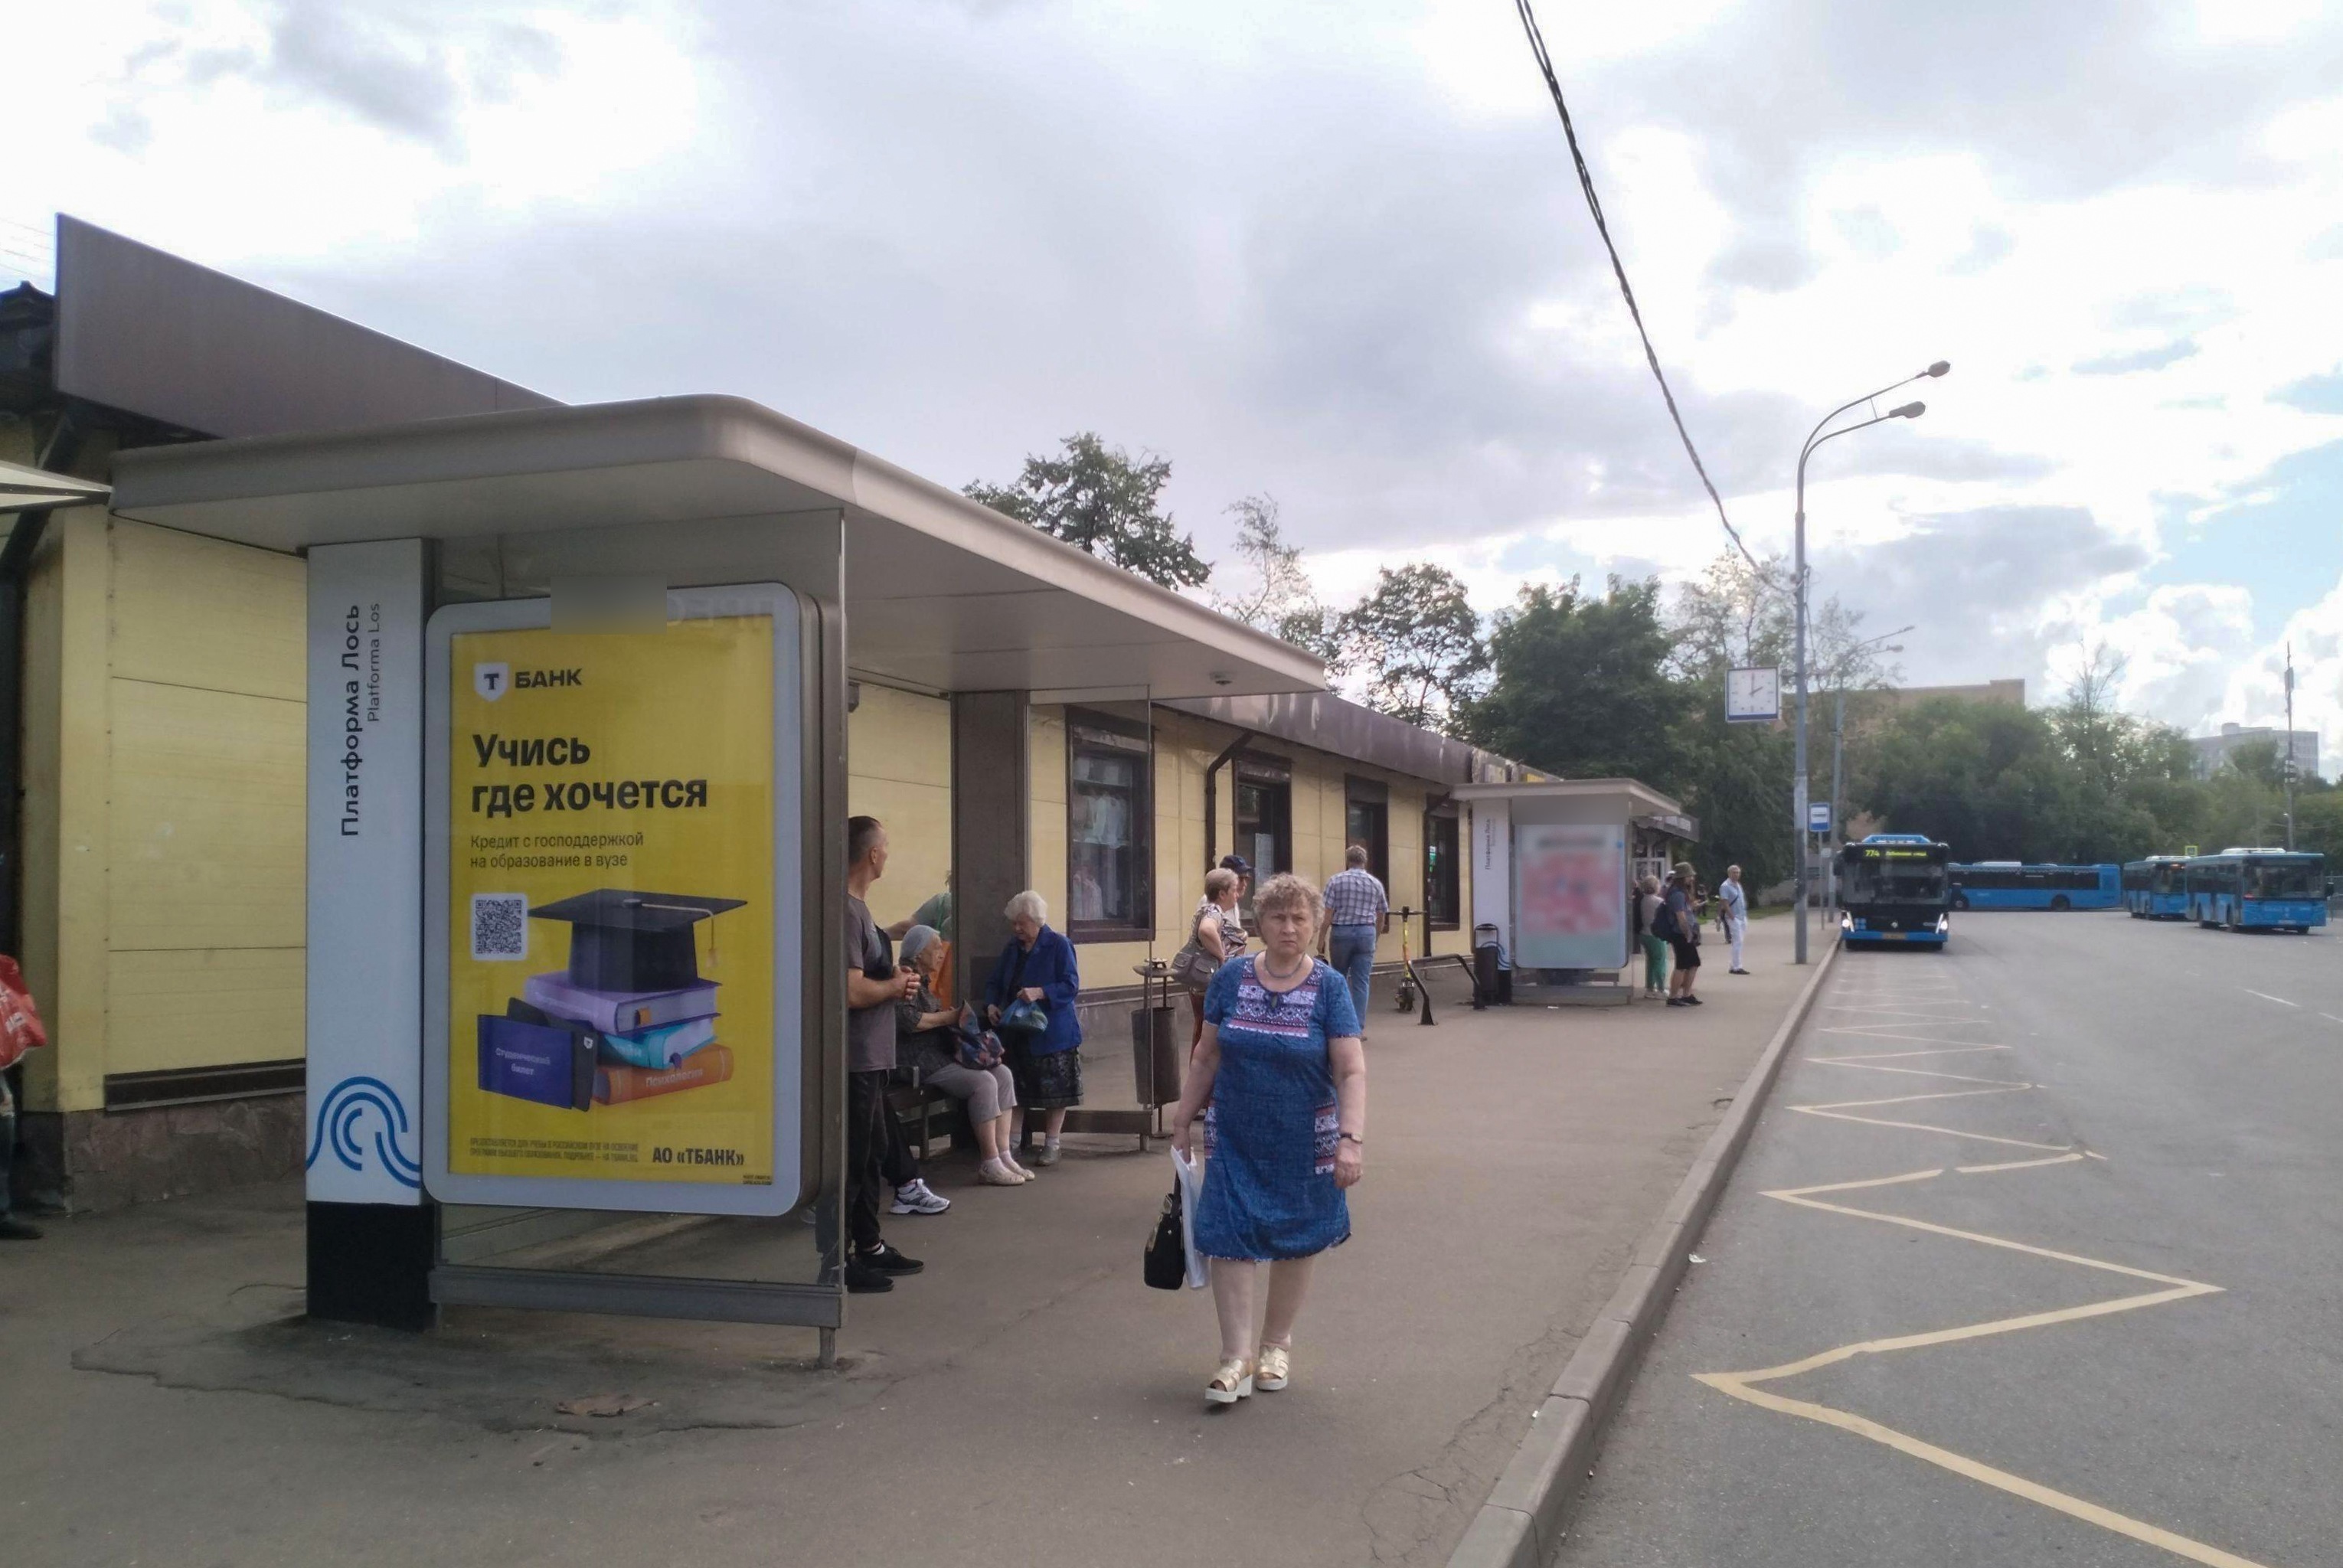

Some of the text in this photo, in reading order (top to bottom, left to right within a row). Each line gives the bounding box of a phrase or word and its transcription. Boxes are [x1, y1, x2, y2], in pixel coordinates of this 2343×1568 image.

[367, 603, 380, 721] Platforma Los
[515, 668, 583, 688] БАНК
[341, 605, 362, 835] Платформа Лось
[472, 733, 590, 768] Учись
[472, 779, 707, 818] где хочется
[470, 832, 644, 851] Кредит с господдержкой
[470, 854, 628, 870] на образование в вузе
[652, 1148, 672, 1163] АО
[677, 1148, 744, 1165] «ТБАНК»
